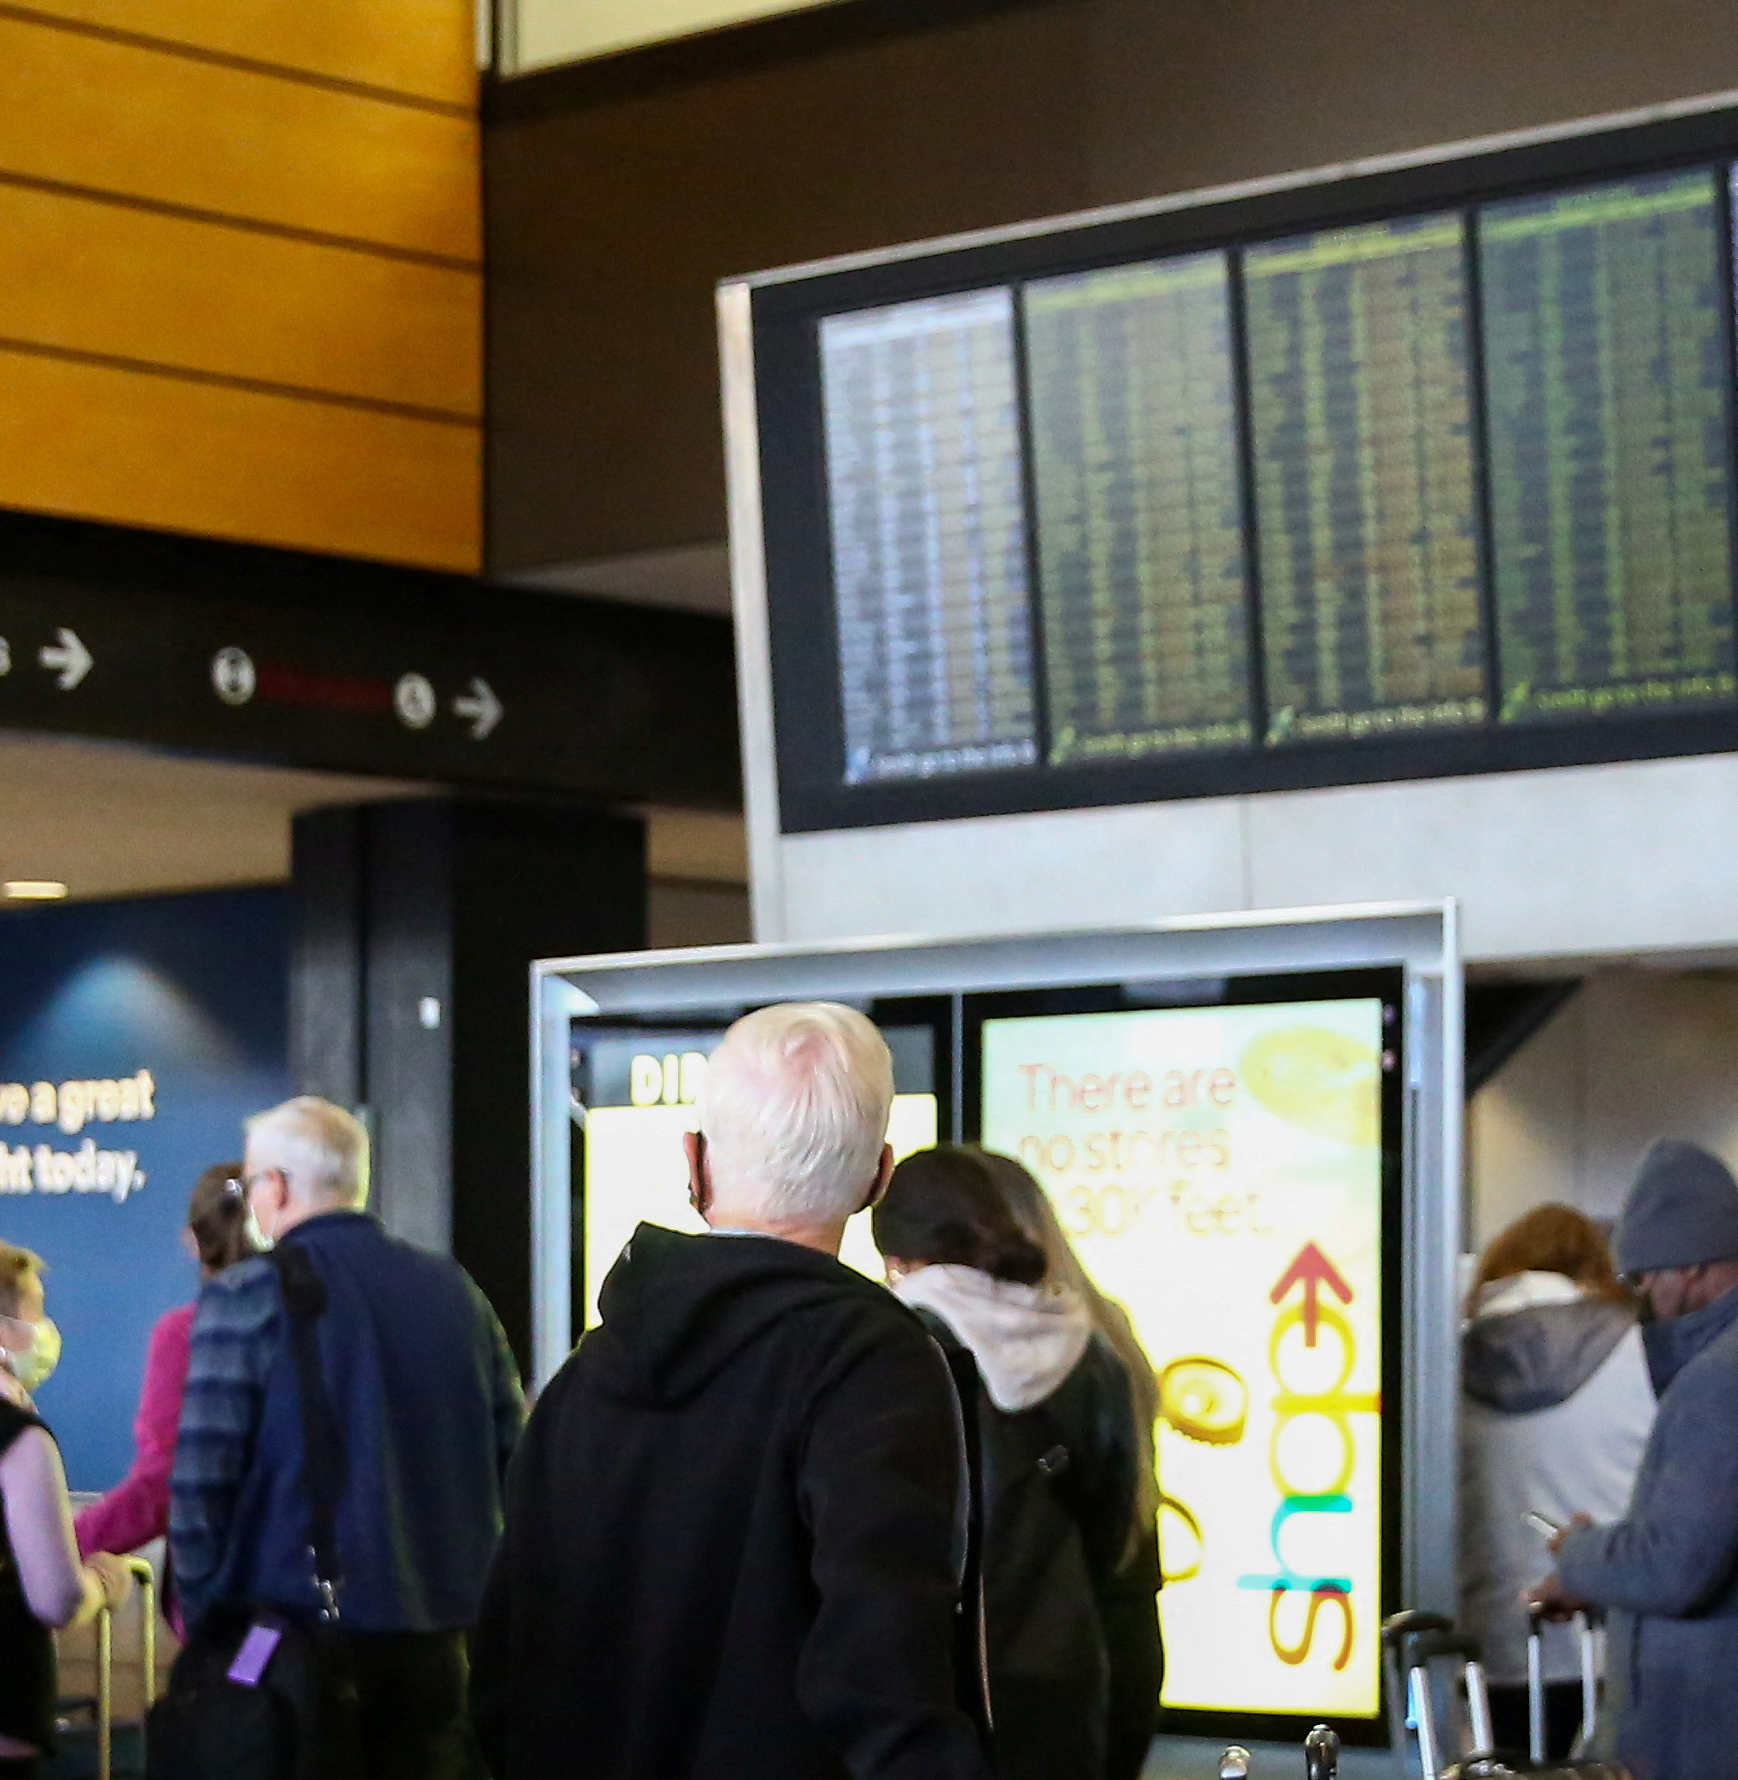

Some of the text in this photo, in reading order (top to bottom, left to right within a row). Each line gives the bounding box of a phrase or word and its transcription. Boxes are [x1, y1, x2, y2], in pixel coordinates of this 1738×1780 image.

[29, 1081, 57, 1124] a
[58, 1067, 156, 1135] great
[1018, 1063, 1238, 1114] There are
[1017, 1128, 1231, 1173] no stores
[1236, 1304, 1383, 1671] shop
